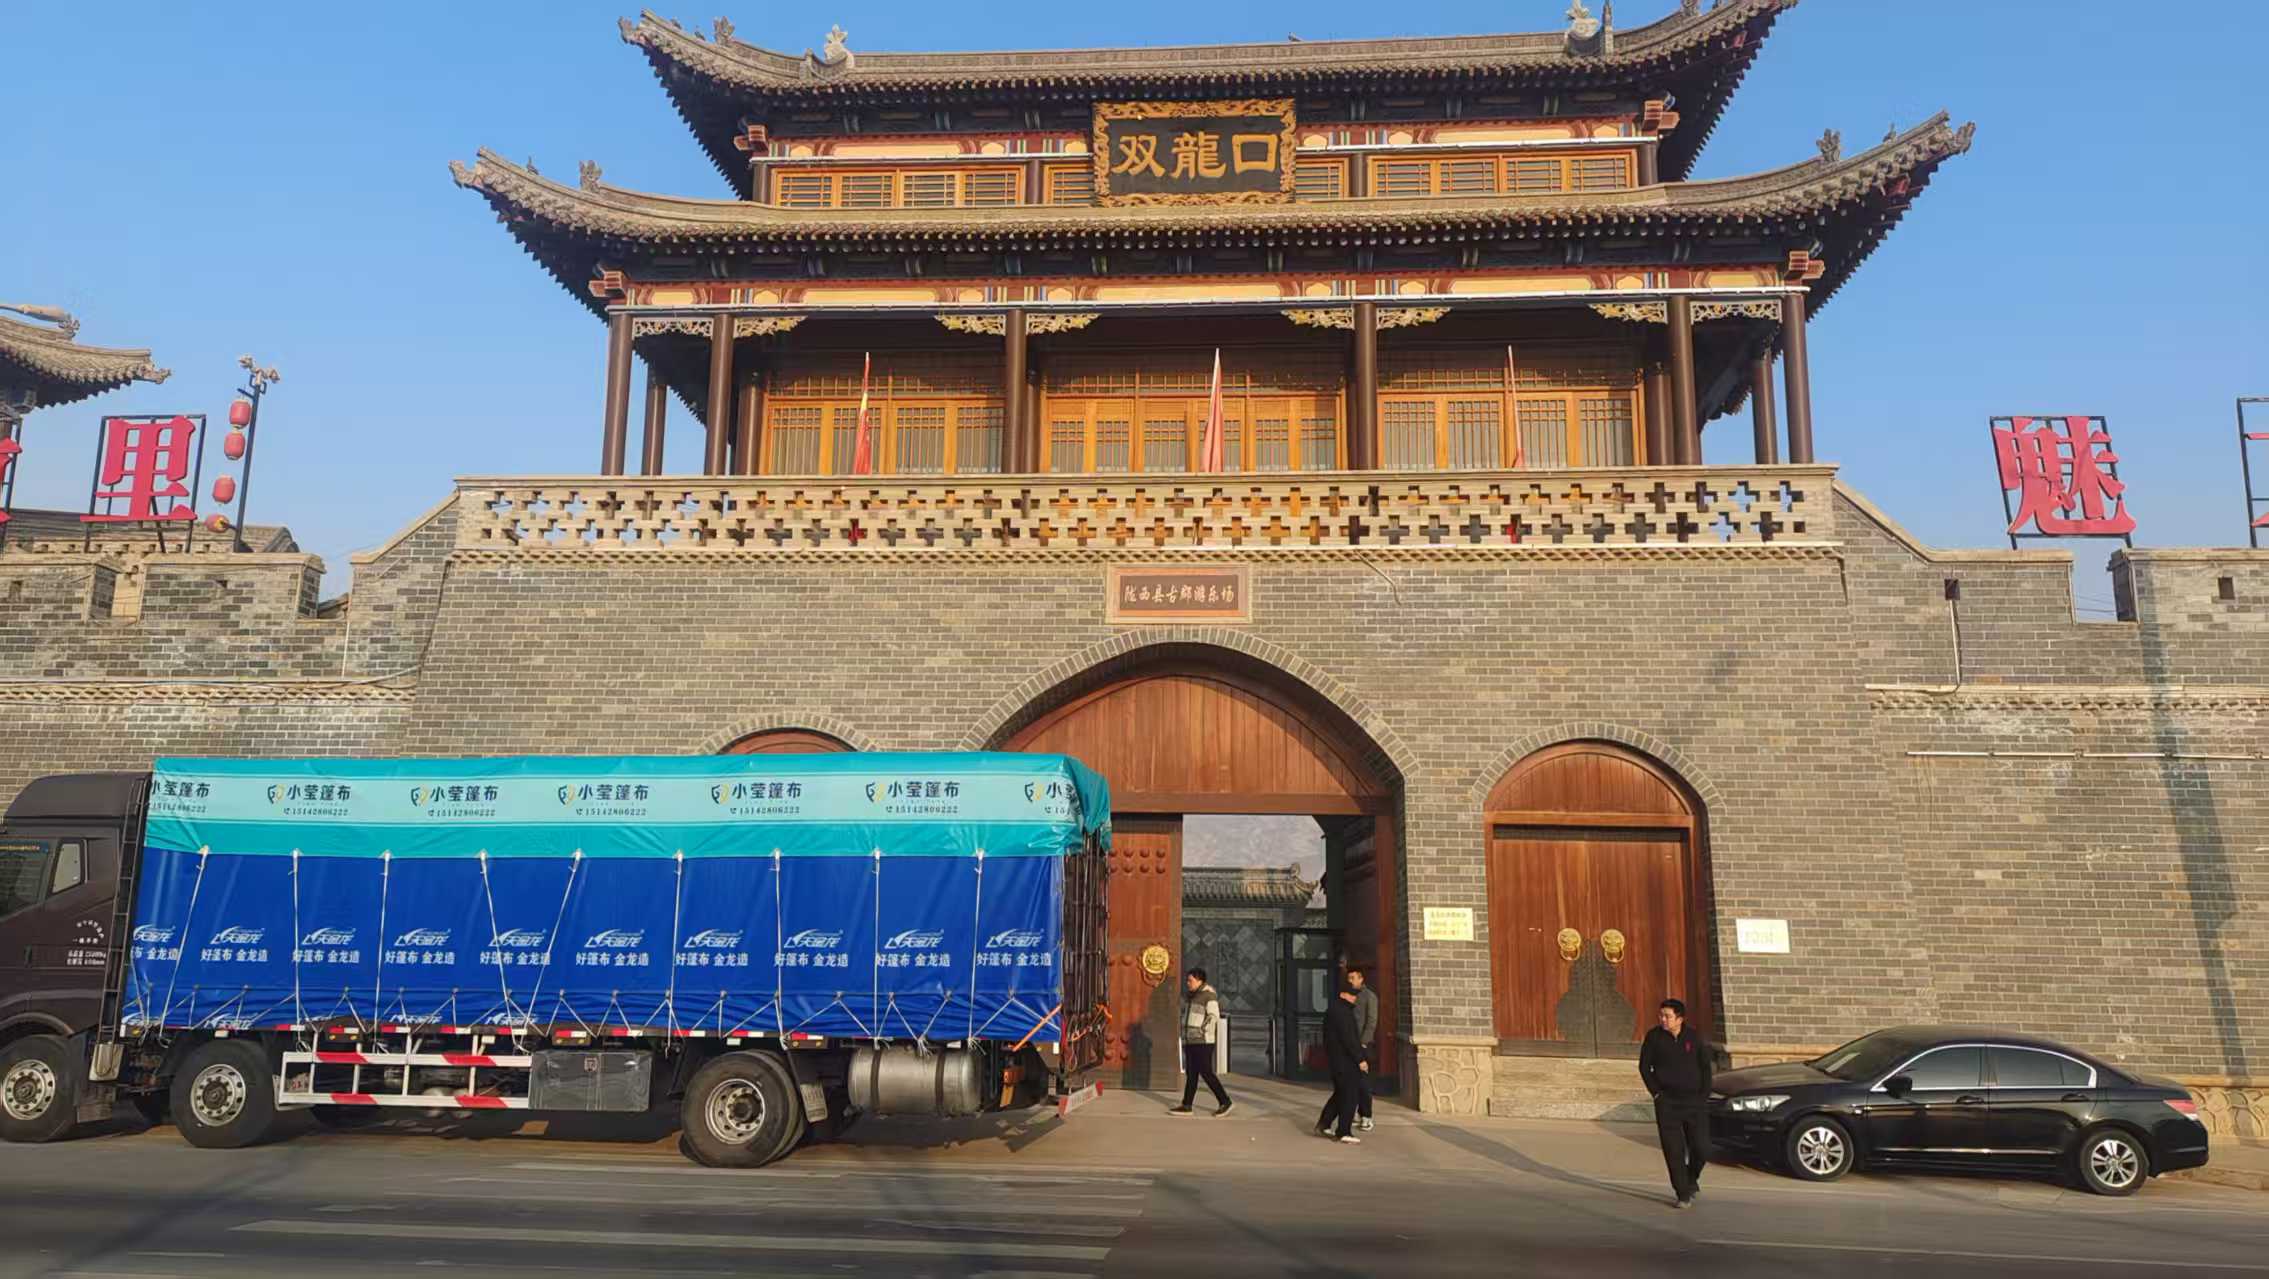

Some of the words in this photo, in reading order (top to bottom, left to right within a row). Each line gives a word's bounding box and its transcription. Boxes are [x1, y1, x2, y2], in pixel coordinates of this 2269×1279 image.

[1111, 131, 1278, 180] 双龍口
[80, 416, 198, 522] 里
[1993, 416, 2137, 534] 魅
